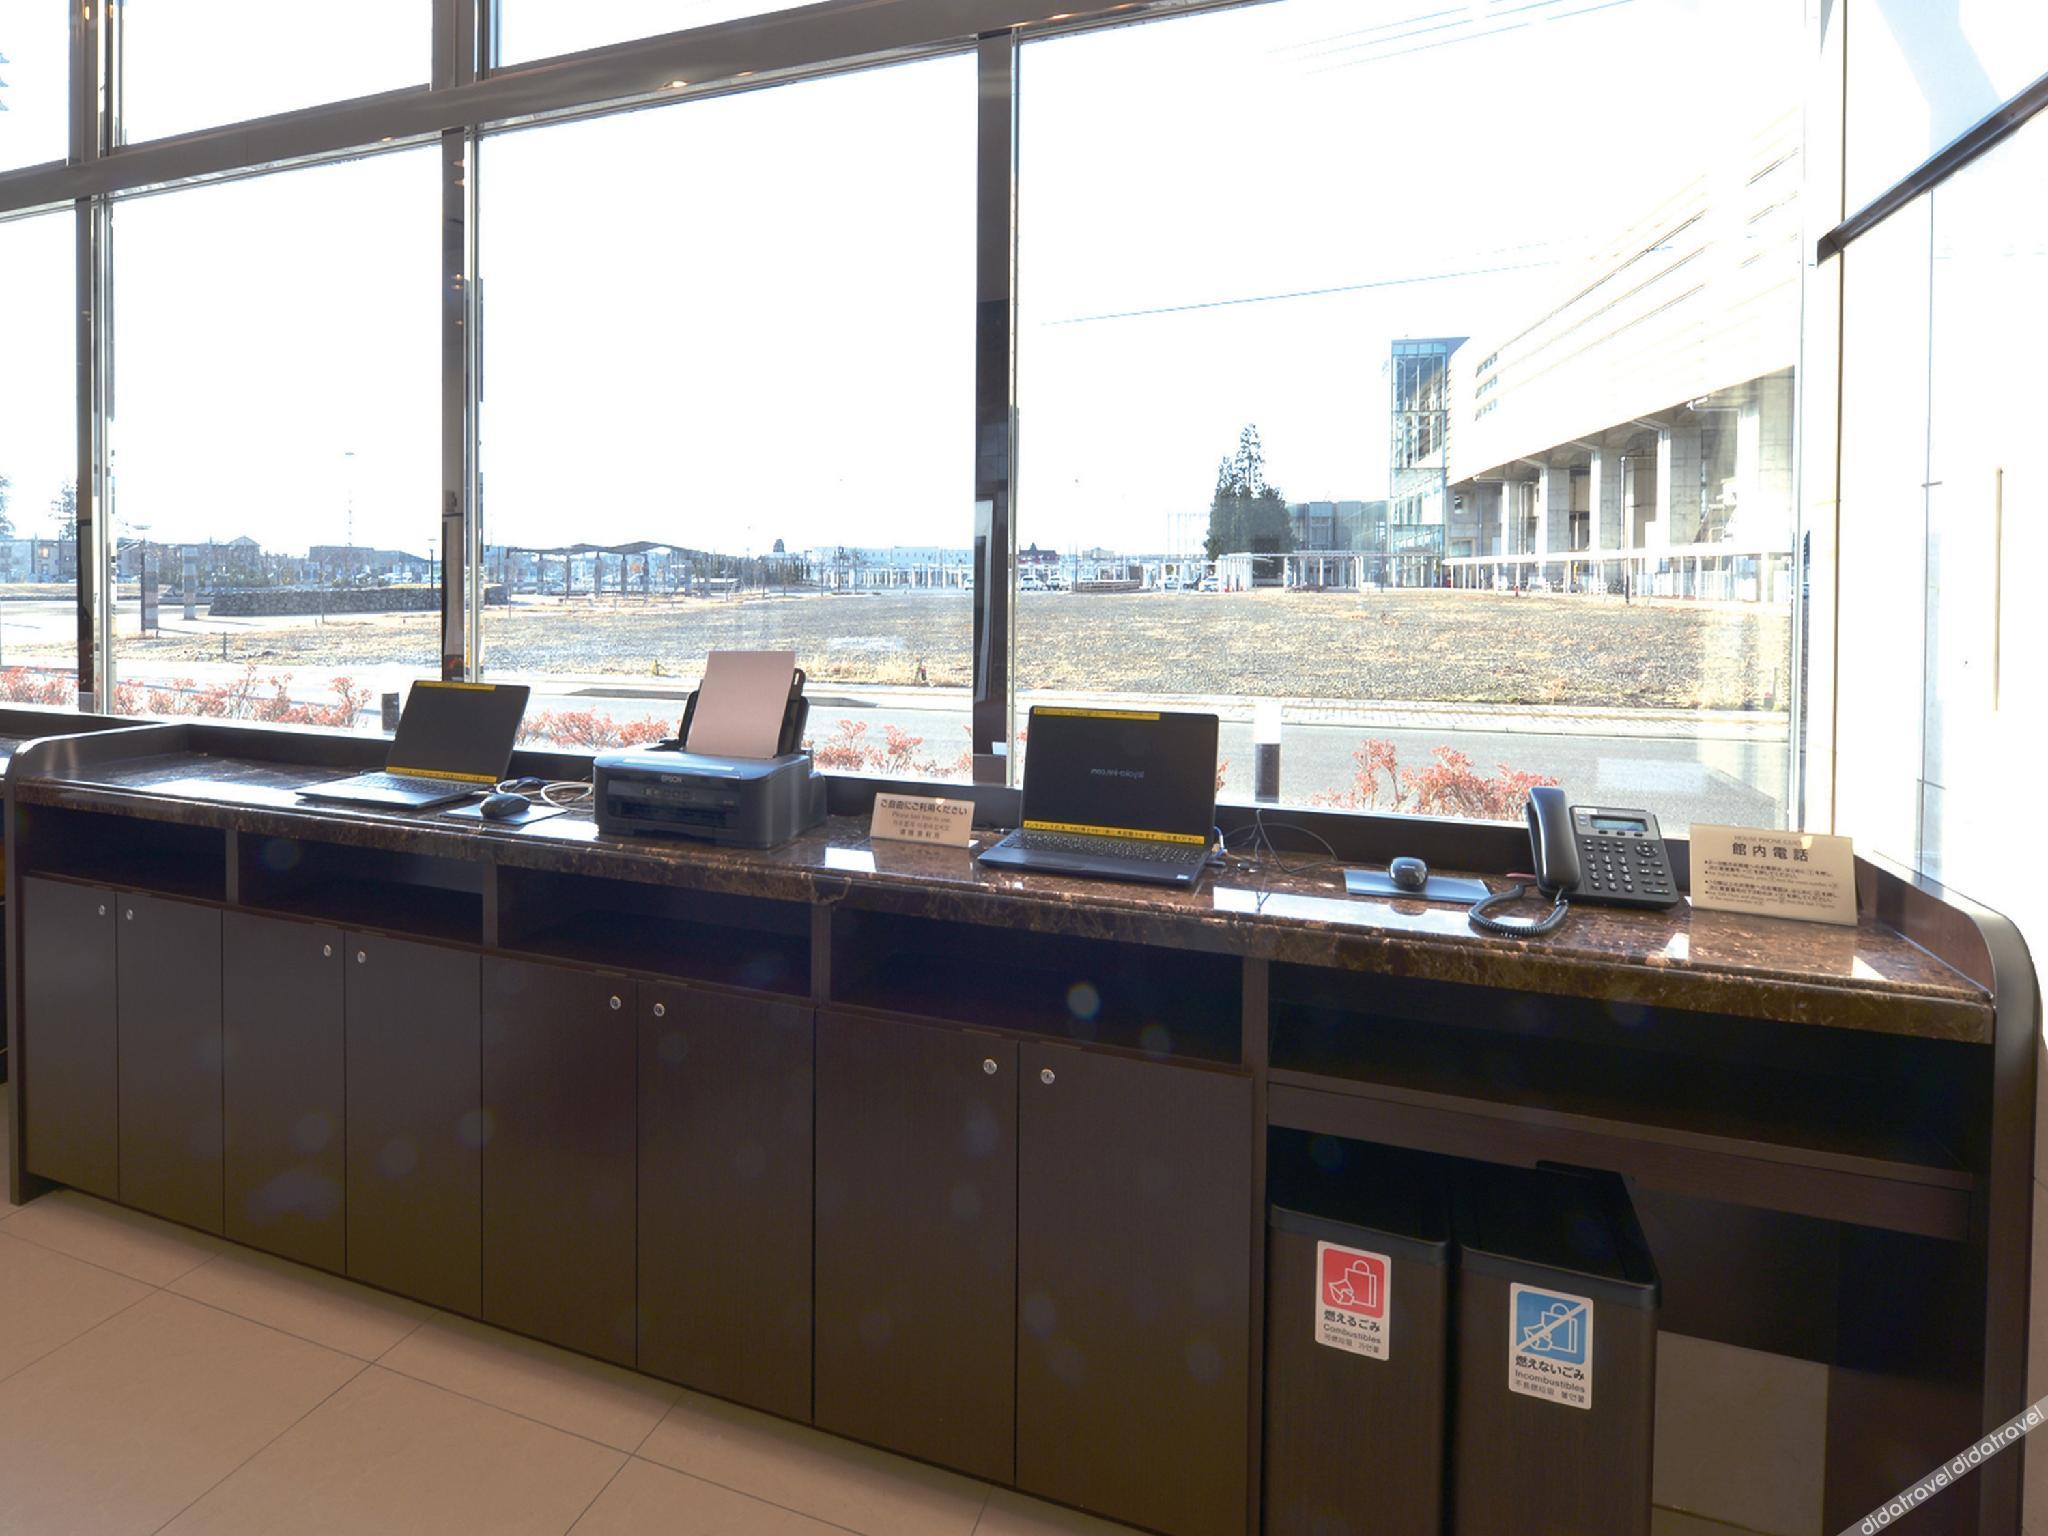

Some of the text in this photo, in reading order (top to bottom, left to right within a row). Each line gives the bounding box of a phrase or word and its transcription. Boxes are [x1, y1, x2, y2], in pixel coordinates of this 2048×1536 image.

[1732, 842, 1809, 863] 館内電話
[1323, 1309, 1380, 1333] 燃えるごみ
[1323, 1323, 1381, 1344] Combustibles
[1515, 1355, 1585, 1381] 燃えないごみ
[1515, 1369, 1585, 1393] Incombustibles
